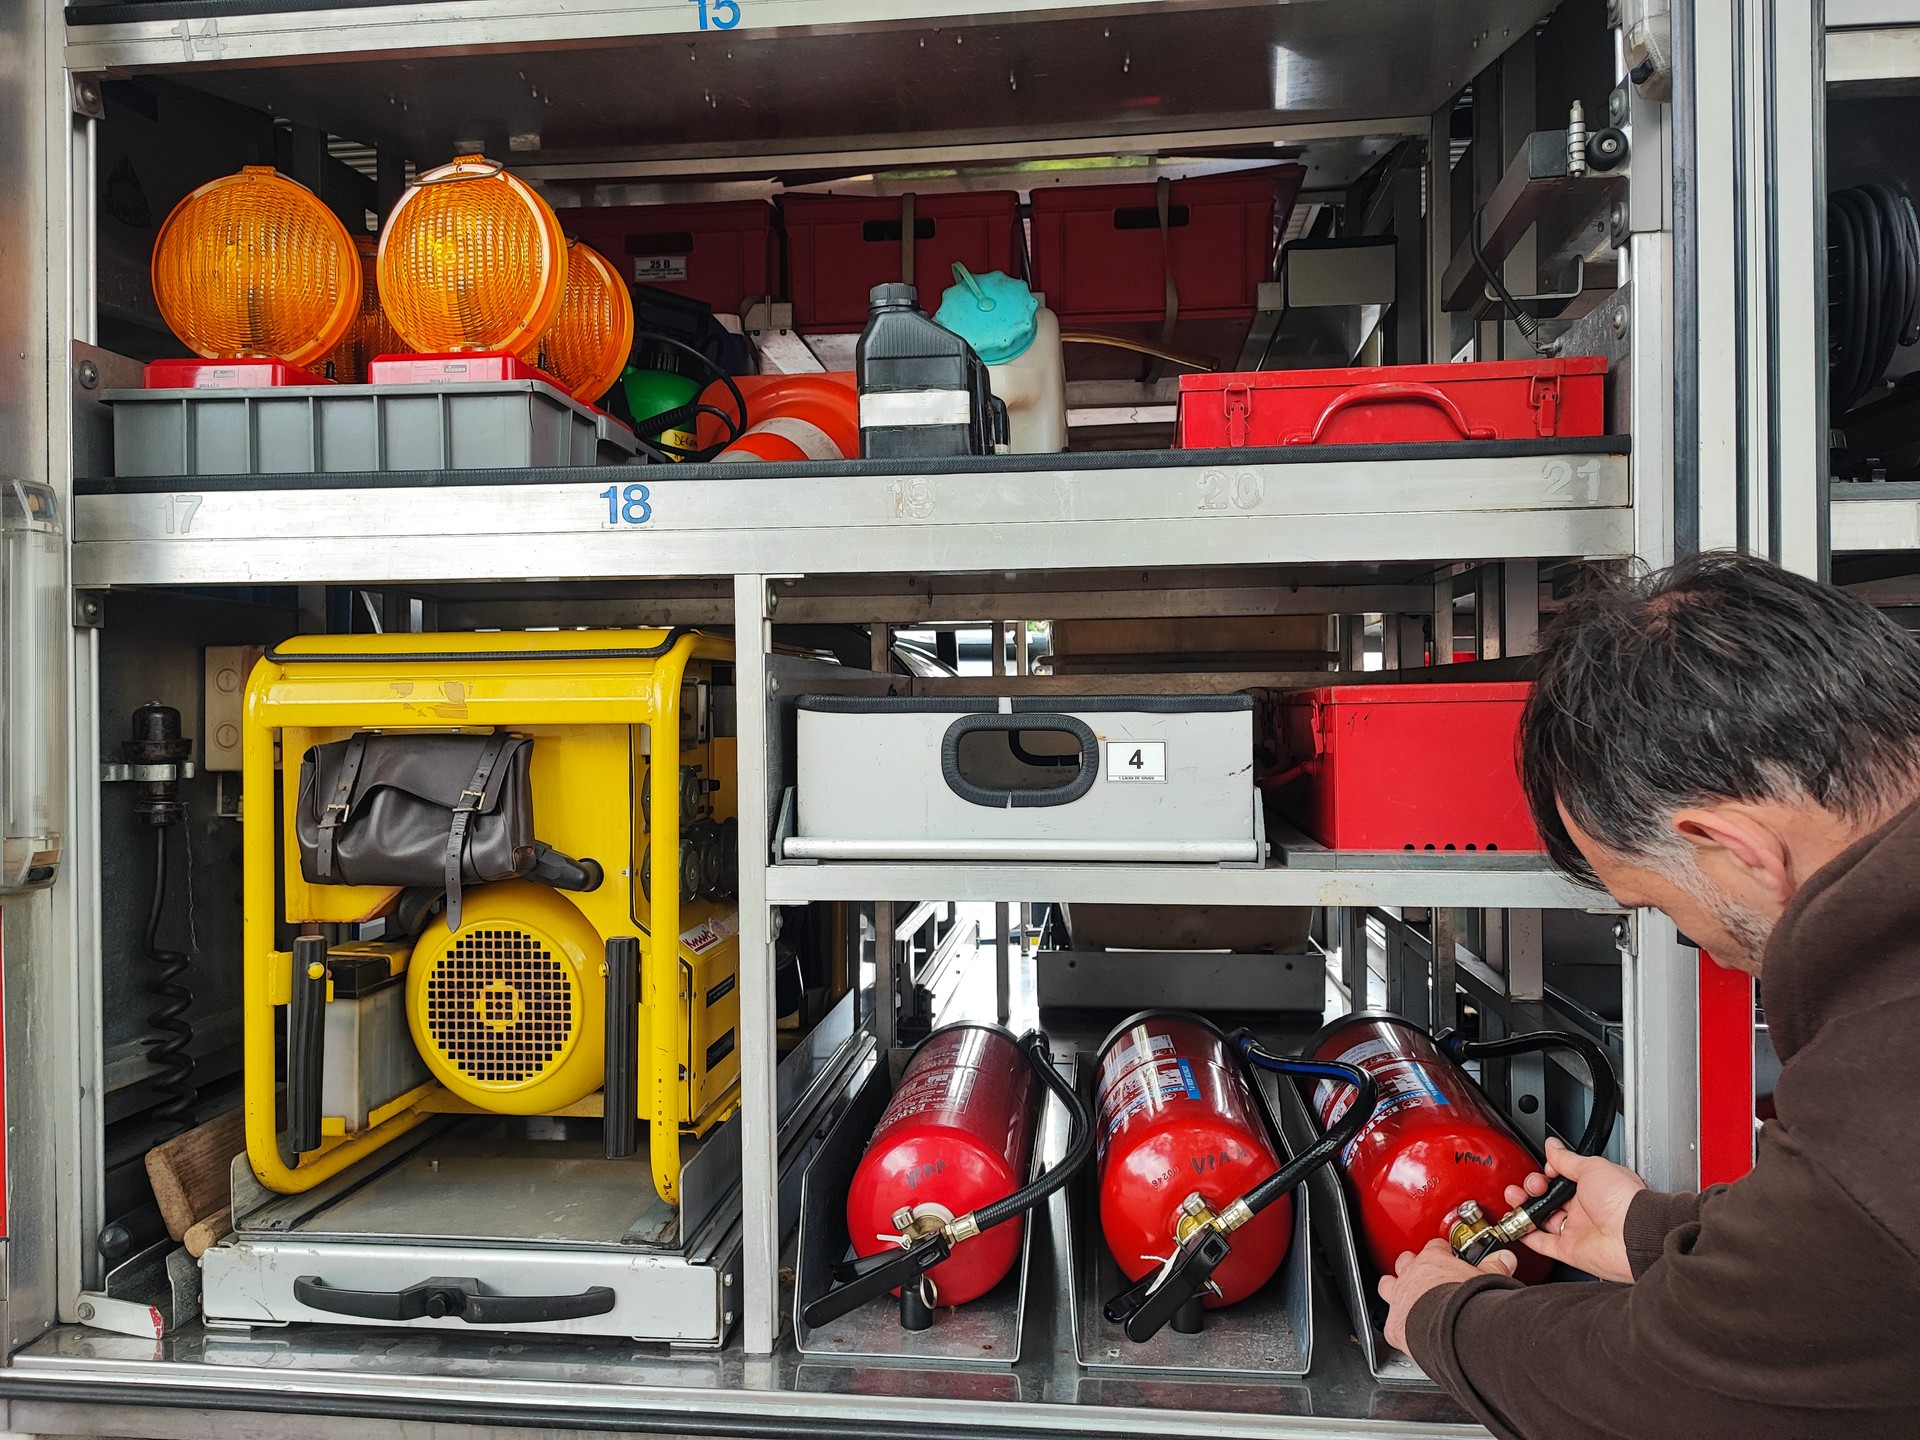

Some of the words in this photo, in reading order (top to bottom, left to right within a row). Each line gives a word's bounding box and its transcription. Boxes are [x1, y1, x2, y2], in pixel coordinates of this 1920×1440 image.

[688, 0, 741, 30] 15
[171, 19, 228, 61] 14
[650, 260, 661, 269] 25
[884, 478, 936, 519] 19
[1197, 468, 1264, 511] 20
[1540, 459, 1600, 504] 21
[156, 494, 203, 534] 17
[600, 484, 652, 524] 18
[1128, 748, 1144, 770] 4
